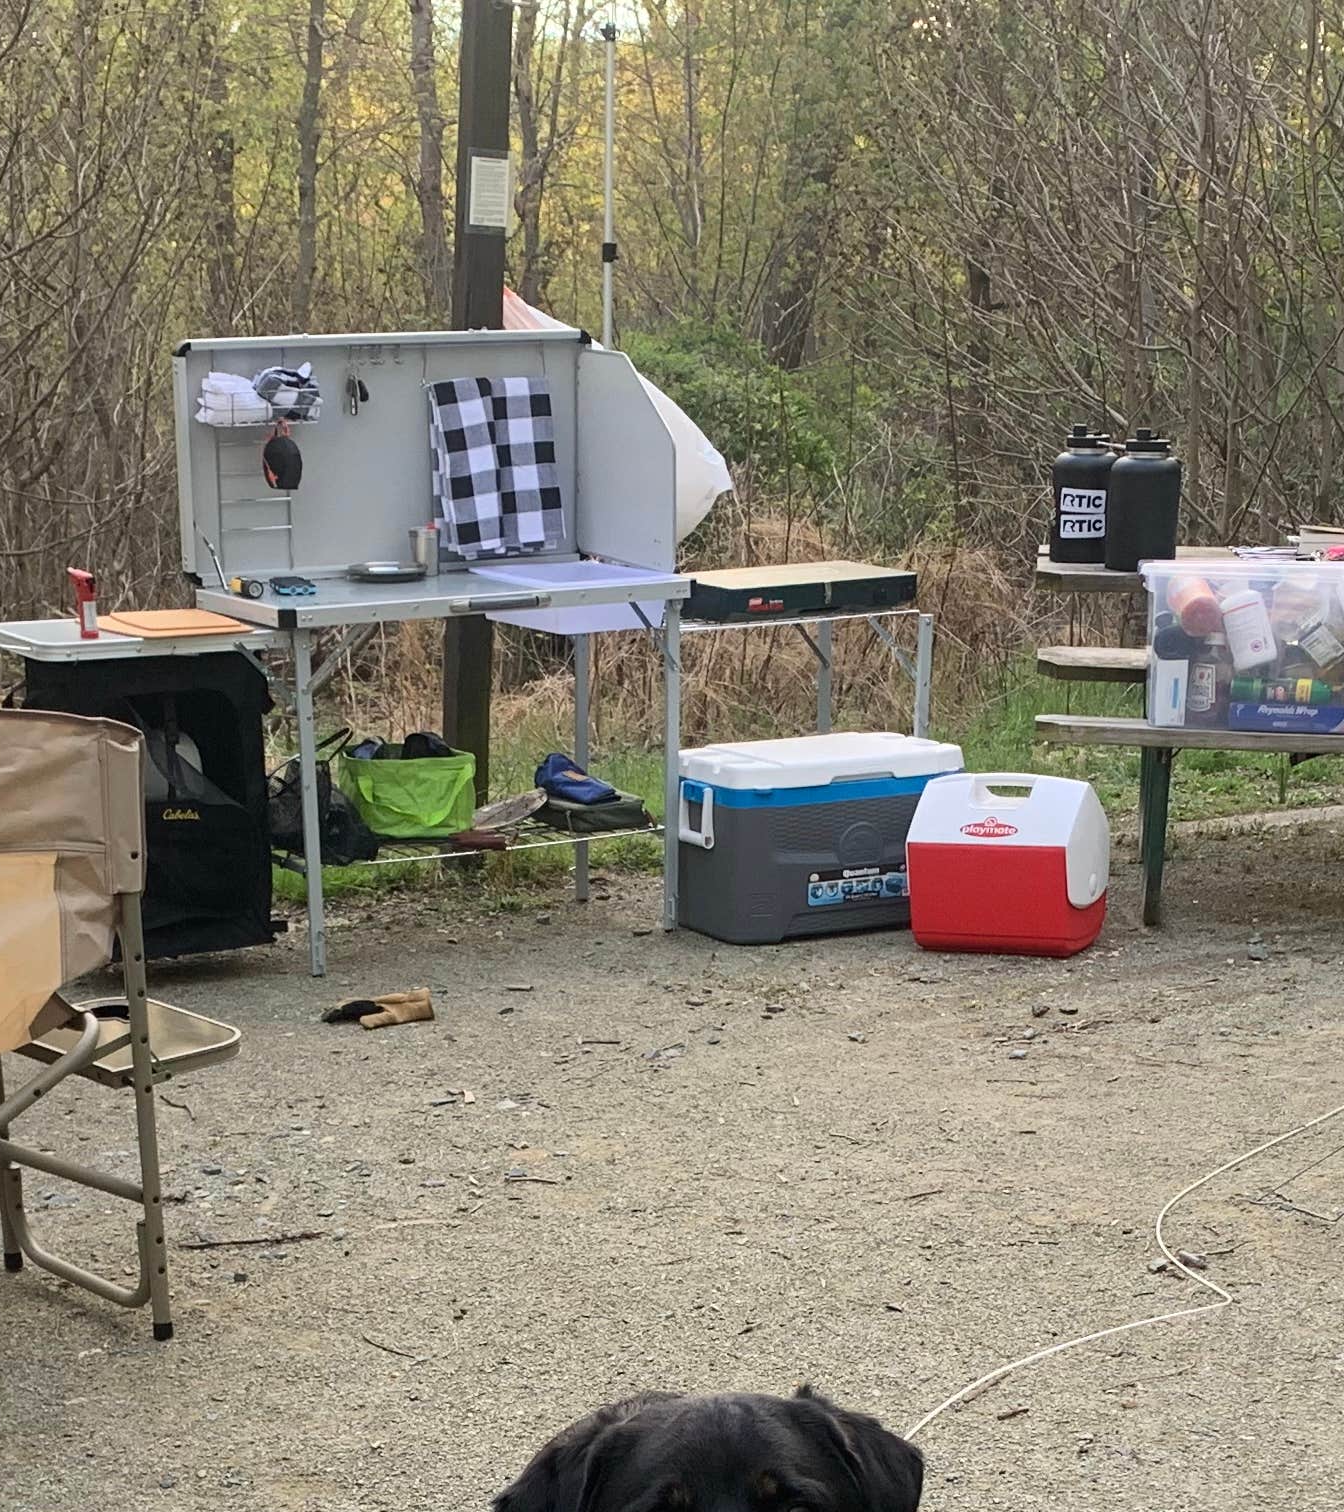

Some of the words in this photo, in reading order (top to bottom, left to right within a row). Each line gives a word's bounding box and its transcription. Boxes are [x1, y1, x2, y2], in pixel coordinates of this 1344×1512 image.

[1063, 494, 1103, 508] RTIC
[1063, 520, 1103, 533] RTIC
[962, 825, 1017, 836] playmate
